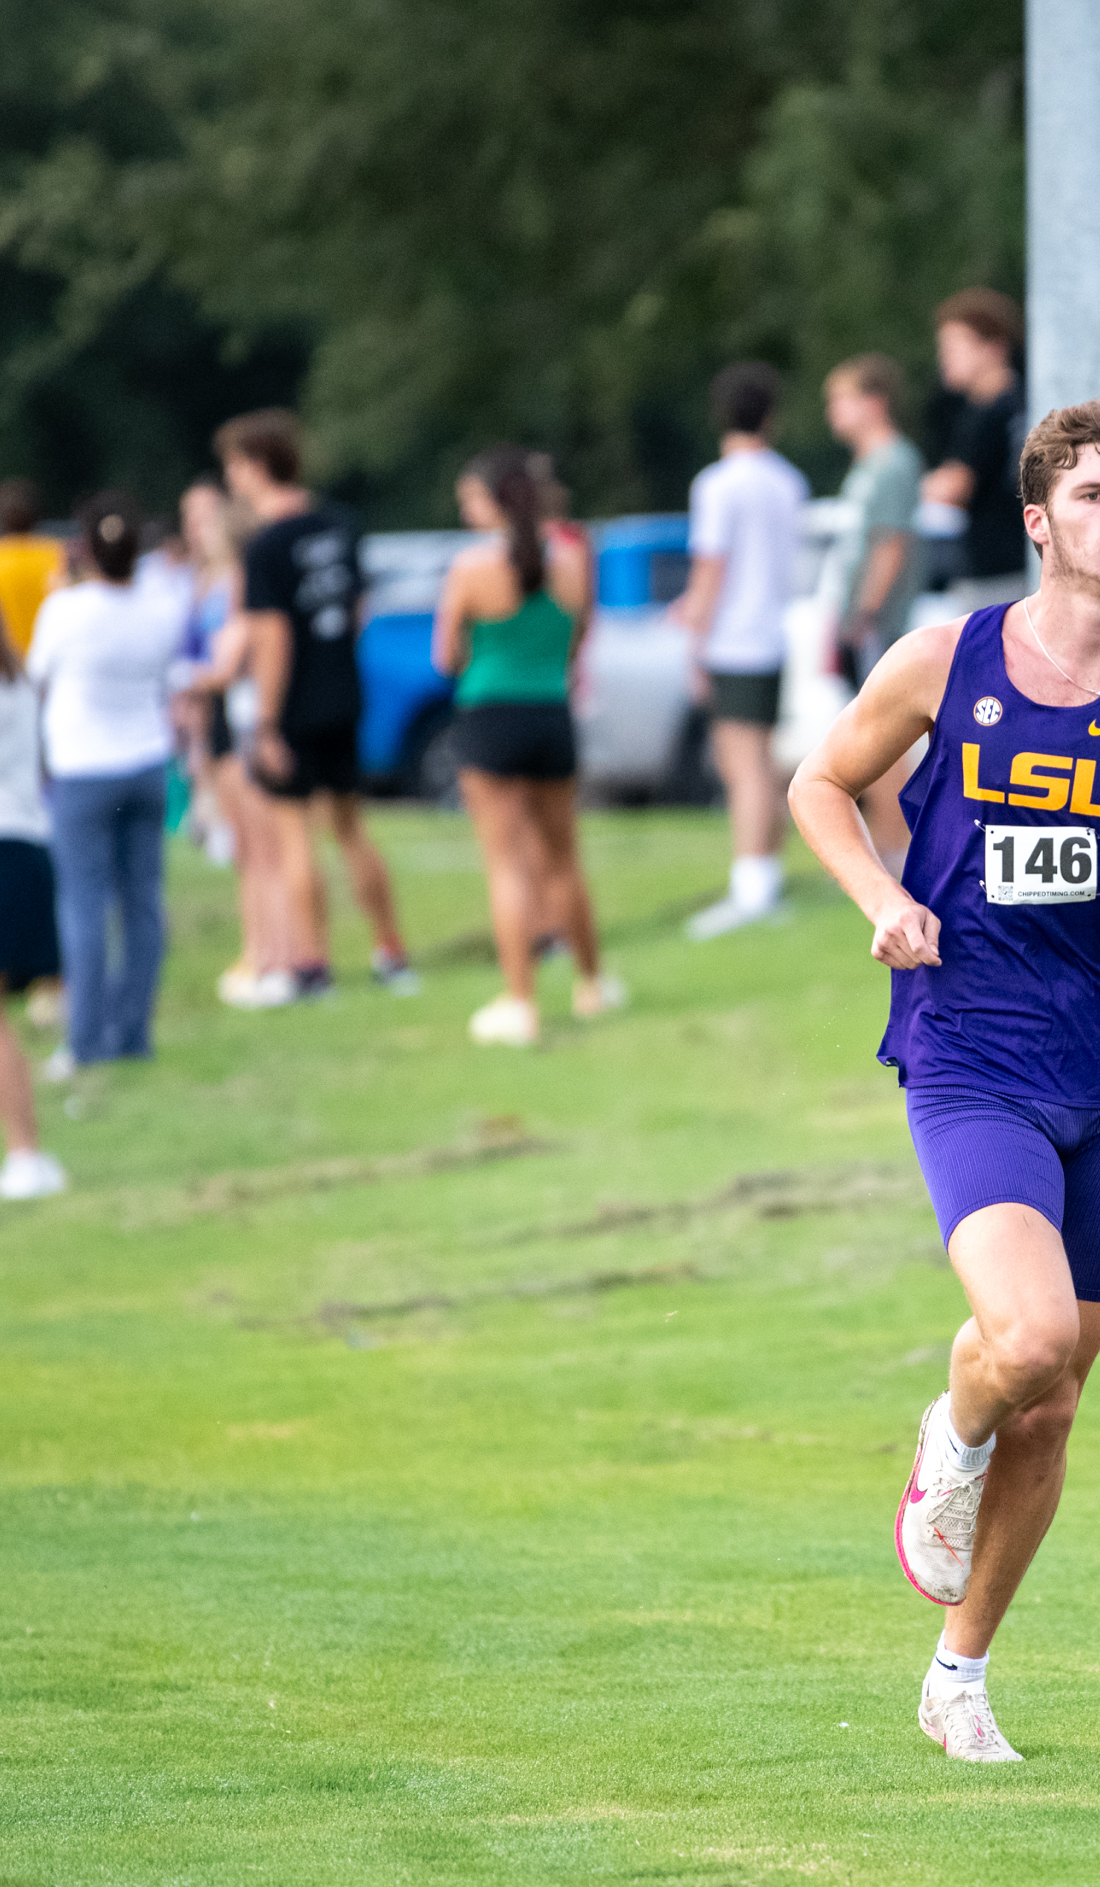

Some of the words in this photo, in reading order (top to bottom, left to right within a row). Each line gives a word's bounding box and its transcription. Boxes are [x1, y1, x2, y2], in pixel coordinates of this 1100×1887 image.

[976, 698, 1001, 724] SEC
[993, 836, 1092, 884] 146
[1017, 890, 1086, 898] CHIPPEDTIMING.COM
